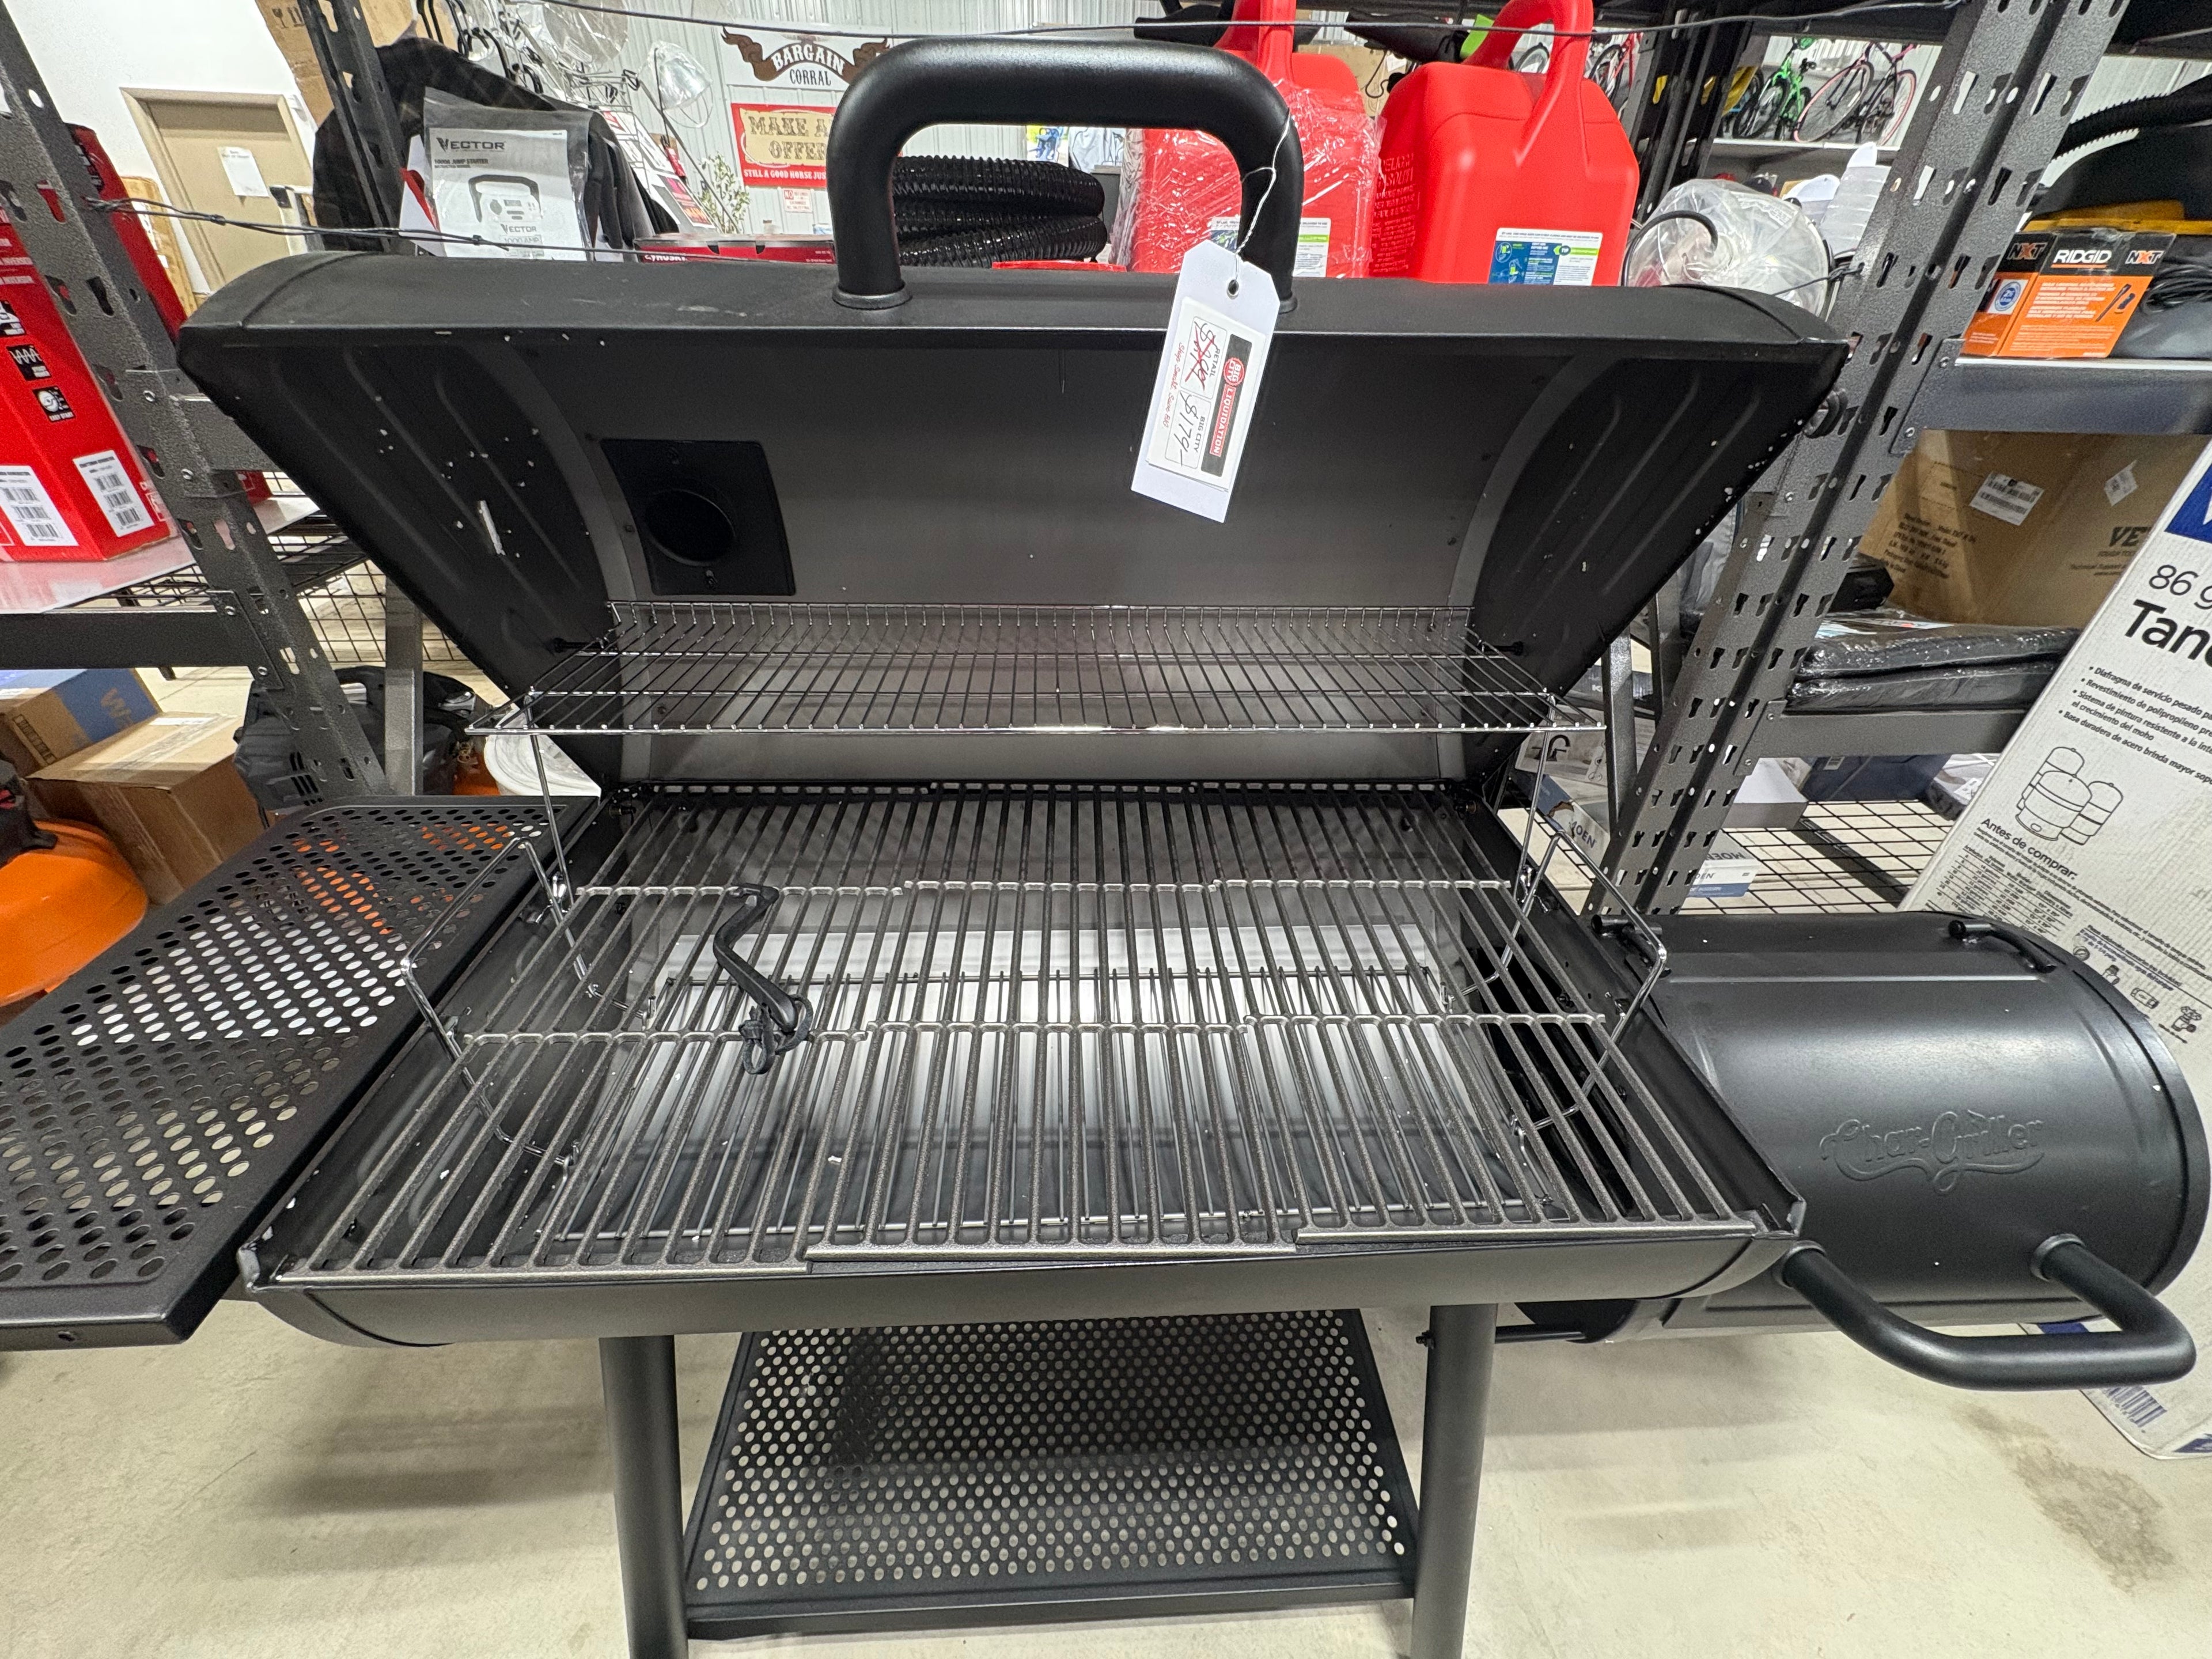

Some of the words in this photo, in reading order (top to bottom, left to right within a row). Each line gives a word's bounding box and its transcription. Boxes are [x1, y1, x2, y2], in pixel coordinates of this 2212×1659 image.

[771, 44, 846, 75] BARGAIN
[789, 69, 831, 86] CORRAL
[748, 116, 809, 137] MAKE
[815, 118, 833, 137] A
[436, 137, 505, 152] VECTOR
[744, 169, 764, 178] STILL
[764, 170, 769, 178] A
[770, 170, 789, 179] GOOD
[790, 171, 812, 179] HORSE
[813, 172, 827, 180] JUS
[784, 190, 793, 199] NO
[500, 224, 537, 234] VECTOR
[2008, 242, 2048, 260] NXT
[2052, 250, 2112, 263] RIDGID
[2125, 250, 2164, 264] NXT
[1209, 349, 1221, 377] RETAIL
[1226, 360, 1235, 381] CITY
[1232, 363, 1241, 382] BIG
[1213, 387, 1233, 454] LIQUIDATION
[1194, 433, 1202, 453] CITY
[2109, 527, 2152, 547] VE
[2149, 565, 2199, 596] 86
[2094, 667, 2132, 687] Diafragma
[2132, 682, 2142, 691] de
[2142, 688, 2172, 703] servicio
[2171, 699, 2202, 715] pesado
[2086, 679, 2136, 704] Revestimiento
[2136, 700, 2147, 709] de
[2146, 704, 2199, 730] polipropileno
[2078, 691, 2105, 707] Sistema
[2105, 703, 2116, 711] de
[2115, 708, 2143, 723] pintura
[2143, 719, 2181, 738] resistente
[2188, 737, 2198, 747] la
[2080, 704, 2120, 725] crecimiento
[2120, 721, 2133, 732] del
[2132, 728, 2154, 741] moho
[2063, 711, 2080, 723] Base
[2080, 719, 2111, 737] duradera
[2112, 734, 2122, 743] de
[2122, 739, 2143, 752] acero
[2143, 747, 2169, 764] brinda
[2169, 761, 2195, 775] mayor
[1980, 819, 2012, 840] Antes
[2012, 837, 2027, 849] de
[2027, 847, 2078, 880] comprar:
